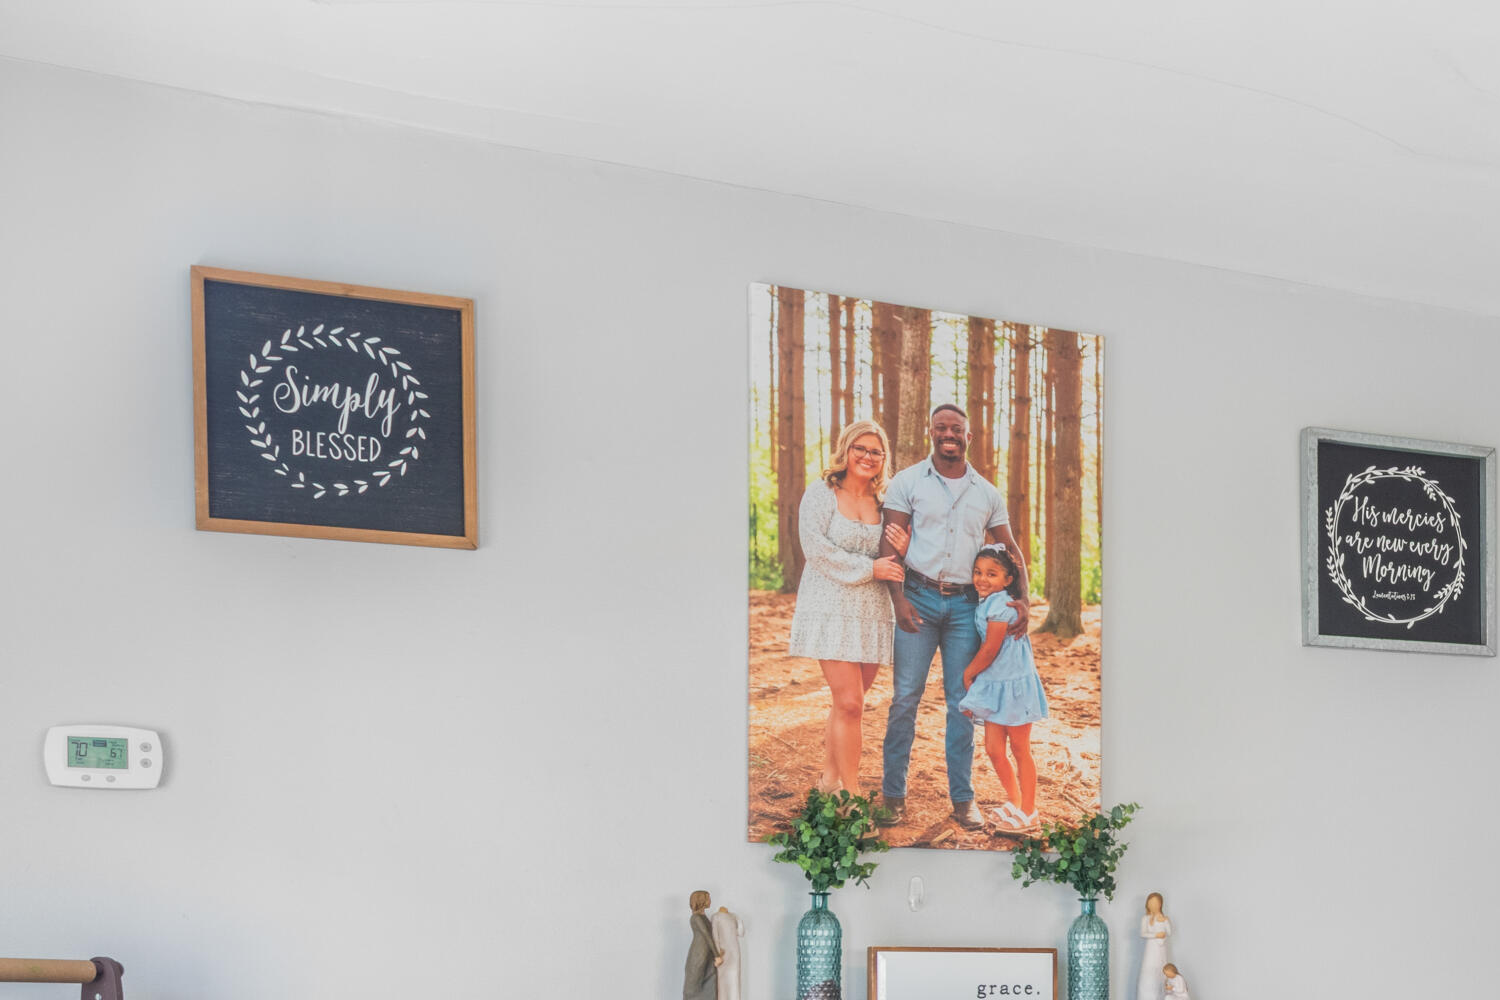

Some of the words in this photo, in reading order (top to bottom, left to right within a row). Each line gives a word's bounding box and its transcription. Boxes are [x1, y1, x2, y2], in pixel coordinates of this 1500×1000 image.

[273, 365, 402, 438] Simply
[291, 429, 382, 462] BLESSED
[1352, 496, 1380, 527] His
[1382, 508, 1446, 533] mercies
[1345, 531, 1374, 554] are
[1376, 535, 1407, 553] new
[1409, 538, 1453, 565] every
[1363, 553, 1435, 592] Morning
[72, 742, 88, 757] 70
[976, 983, 1041, 999] grace.
